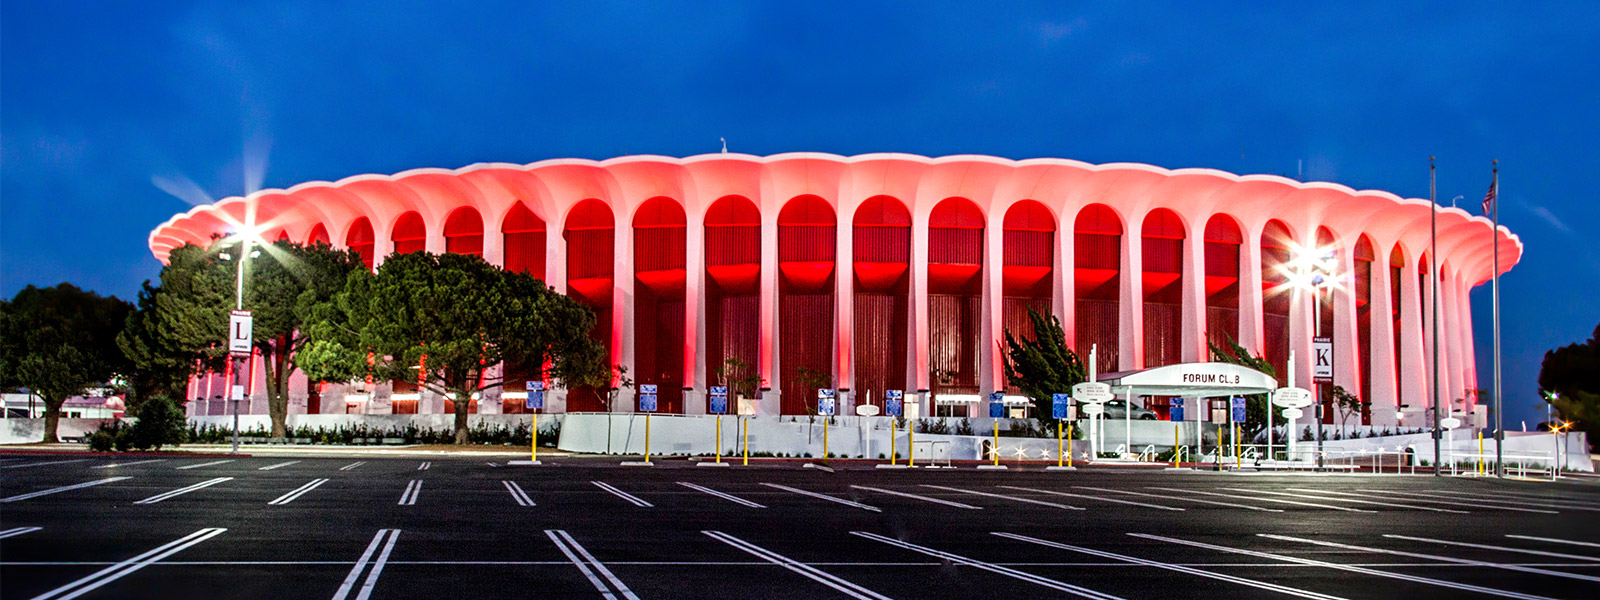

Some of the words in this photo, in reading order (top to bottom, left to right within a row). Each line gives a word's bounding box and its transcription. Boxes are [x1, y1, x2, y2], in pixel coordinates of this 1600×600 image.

[235, 322, 248, 340] L
[1316, 348, 1330, 367] K
[1183, 373, 1216, 383] FORUM
[1219, 374, 1240, 384] CLB
